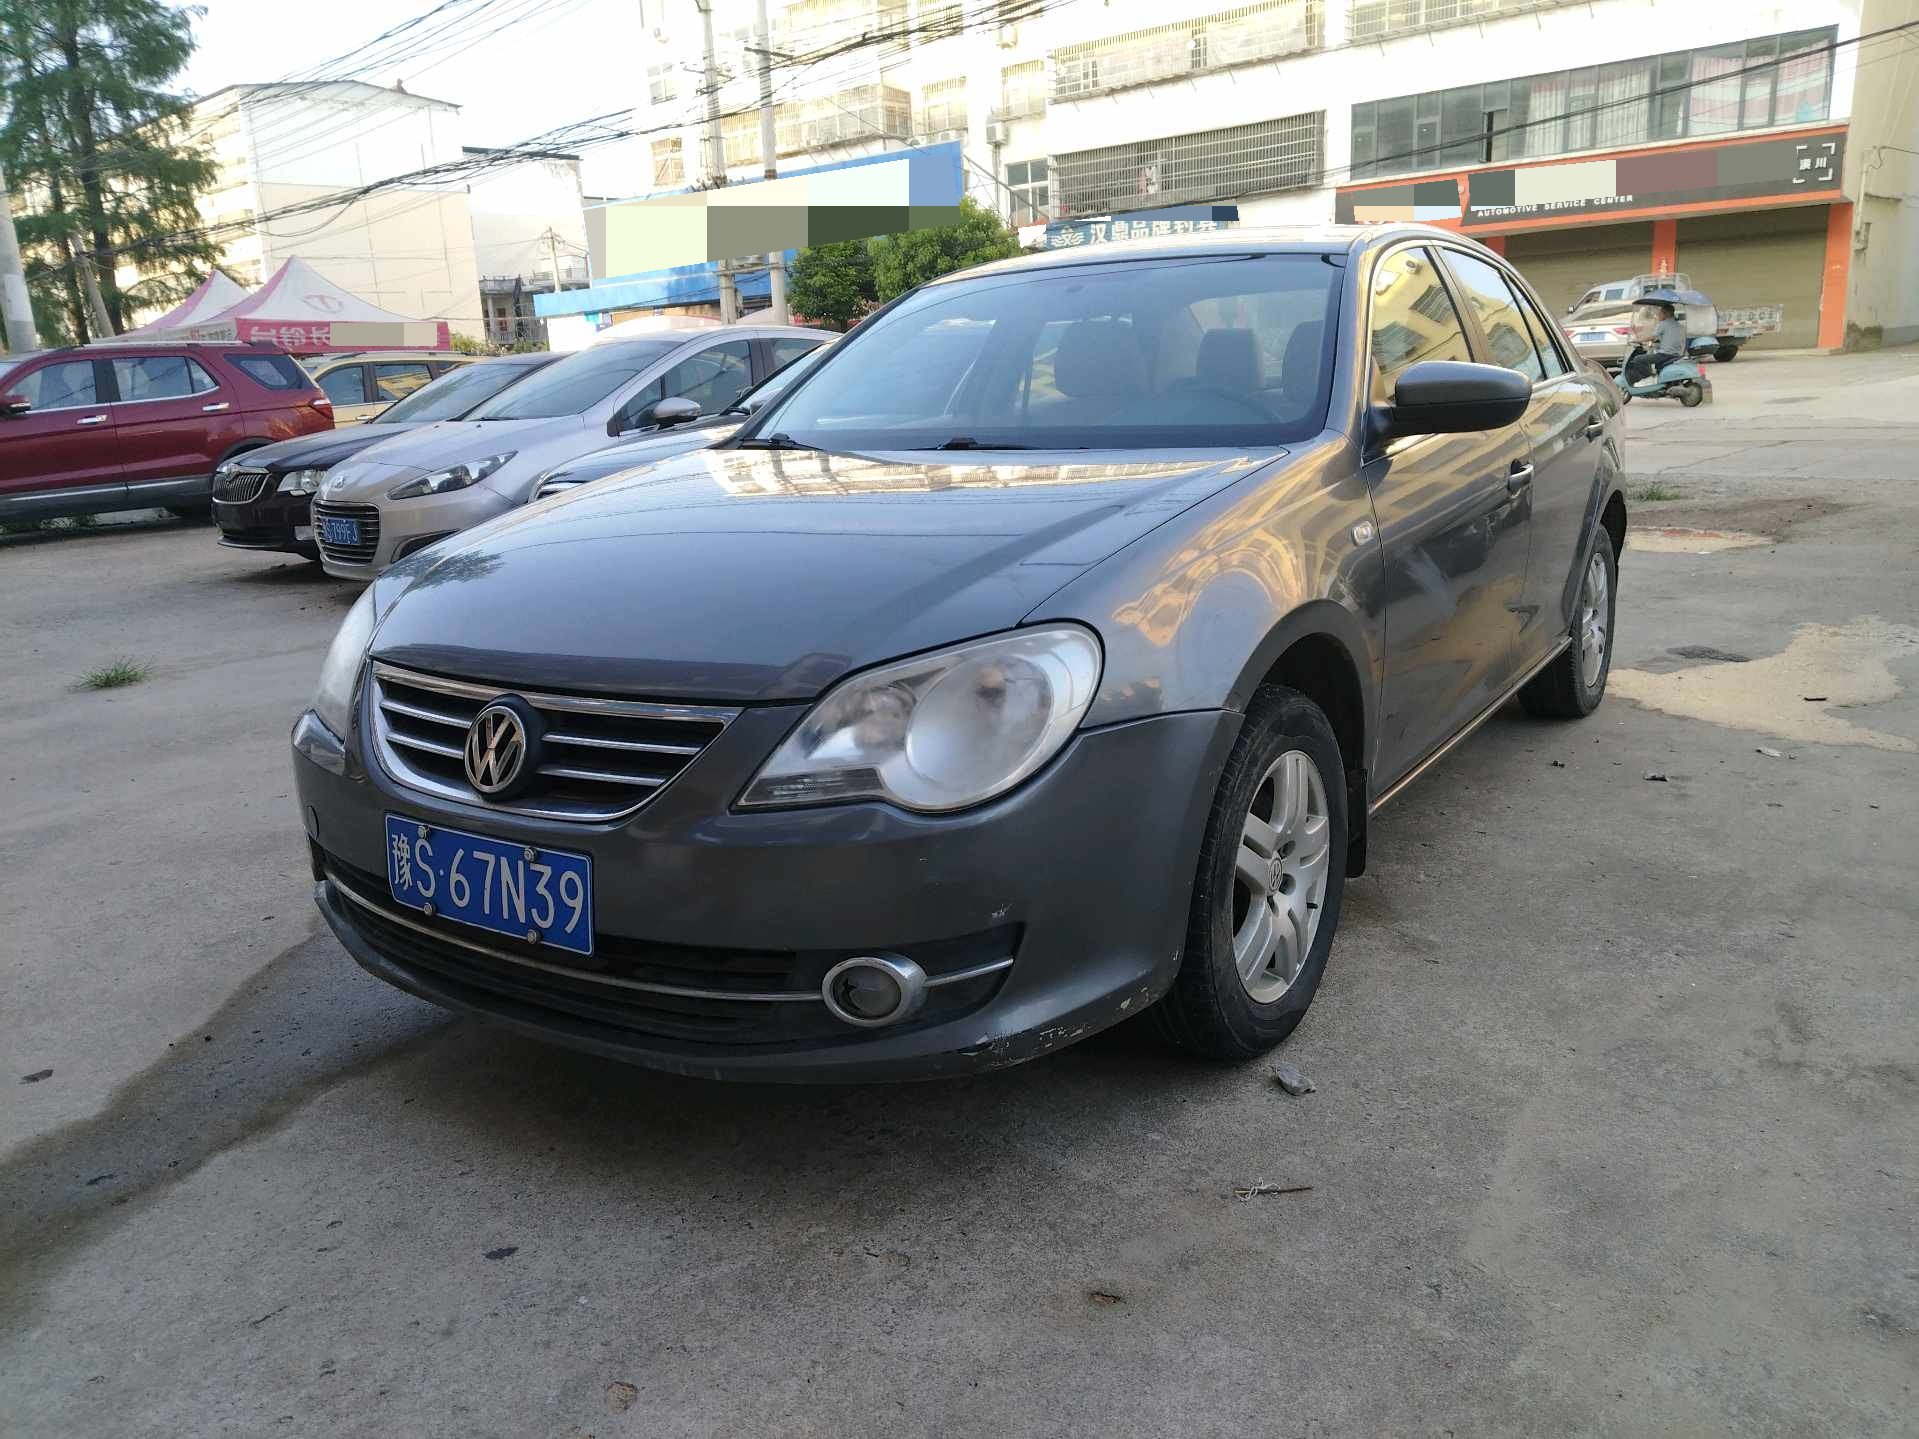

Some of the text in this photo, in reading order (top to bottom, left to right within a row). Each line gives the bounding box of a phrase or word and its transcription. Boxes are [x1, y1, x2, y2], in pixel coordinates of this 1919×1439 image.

[1477, 195, 1633, 217] AUTOMOTIVE SERVICE CENTER
